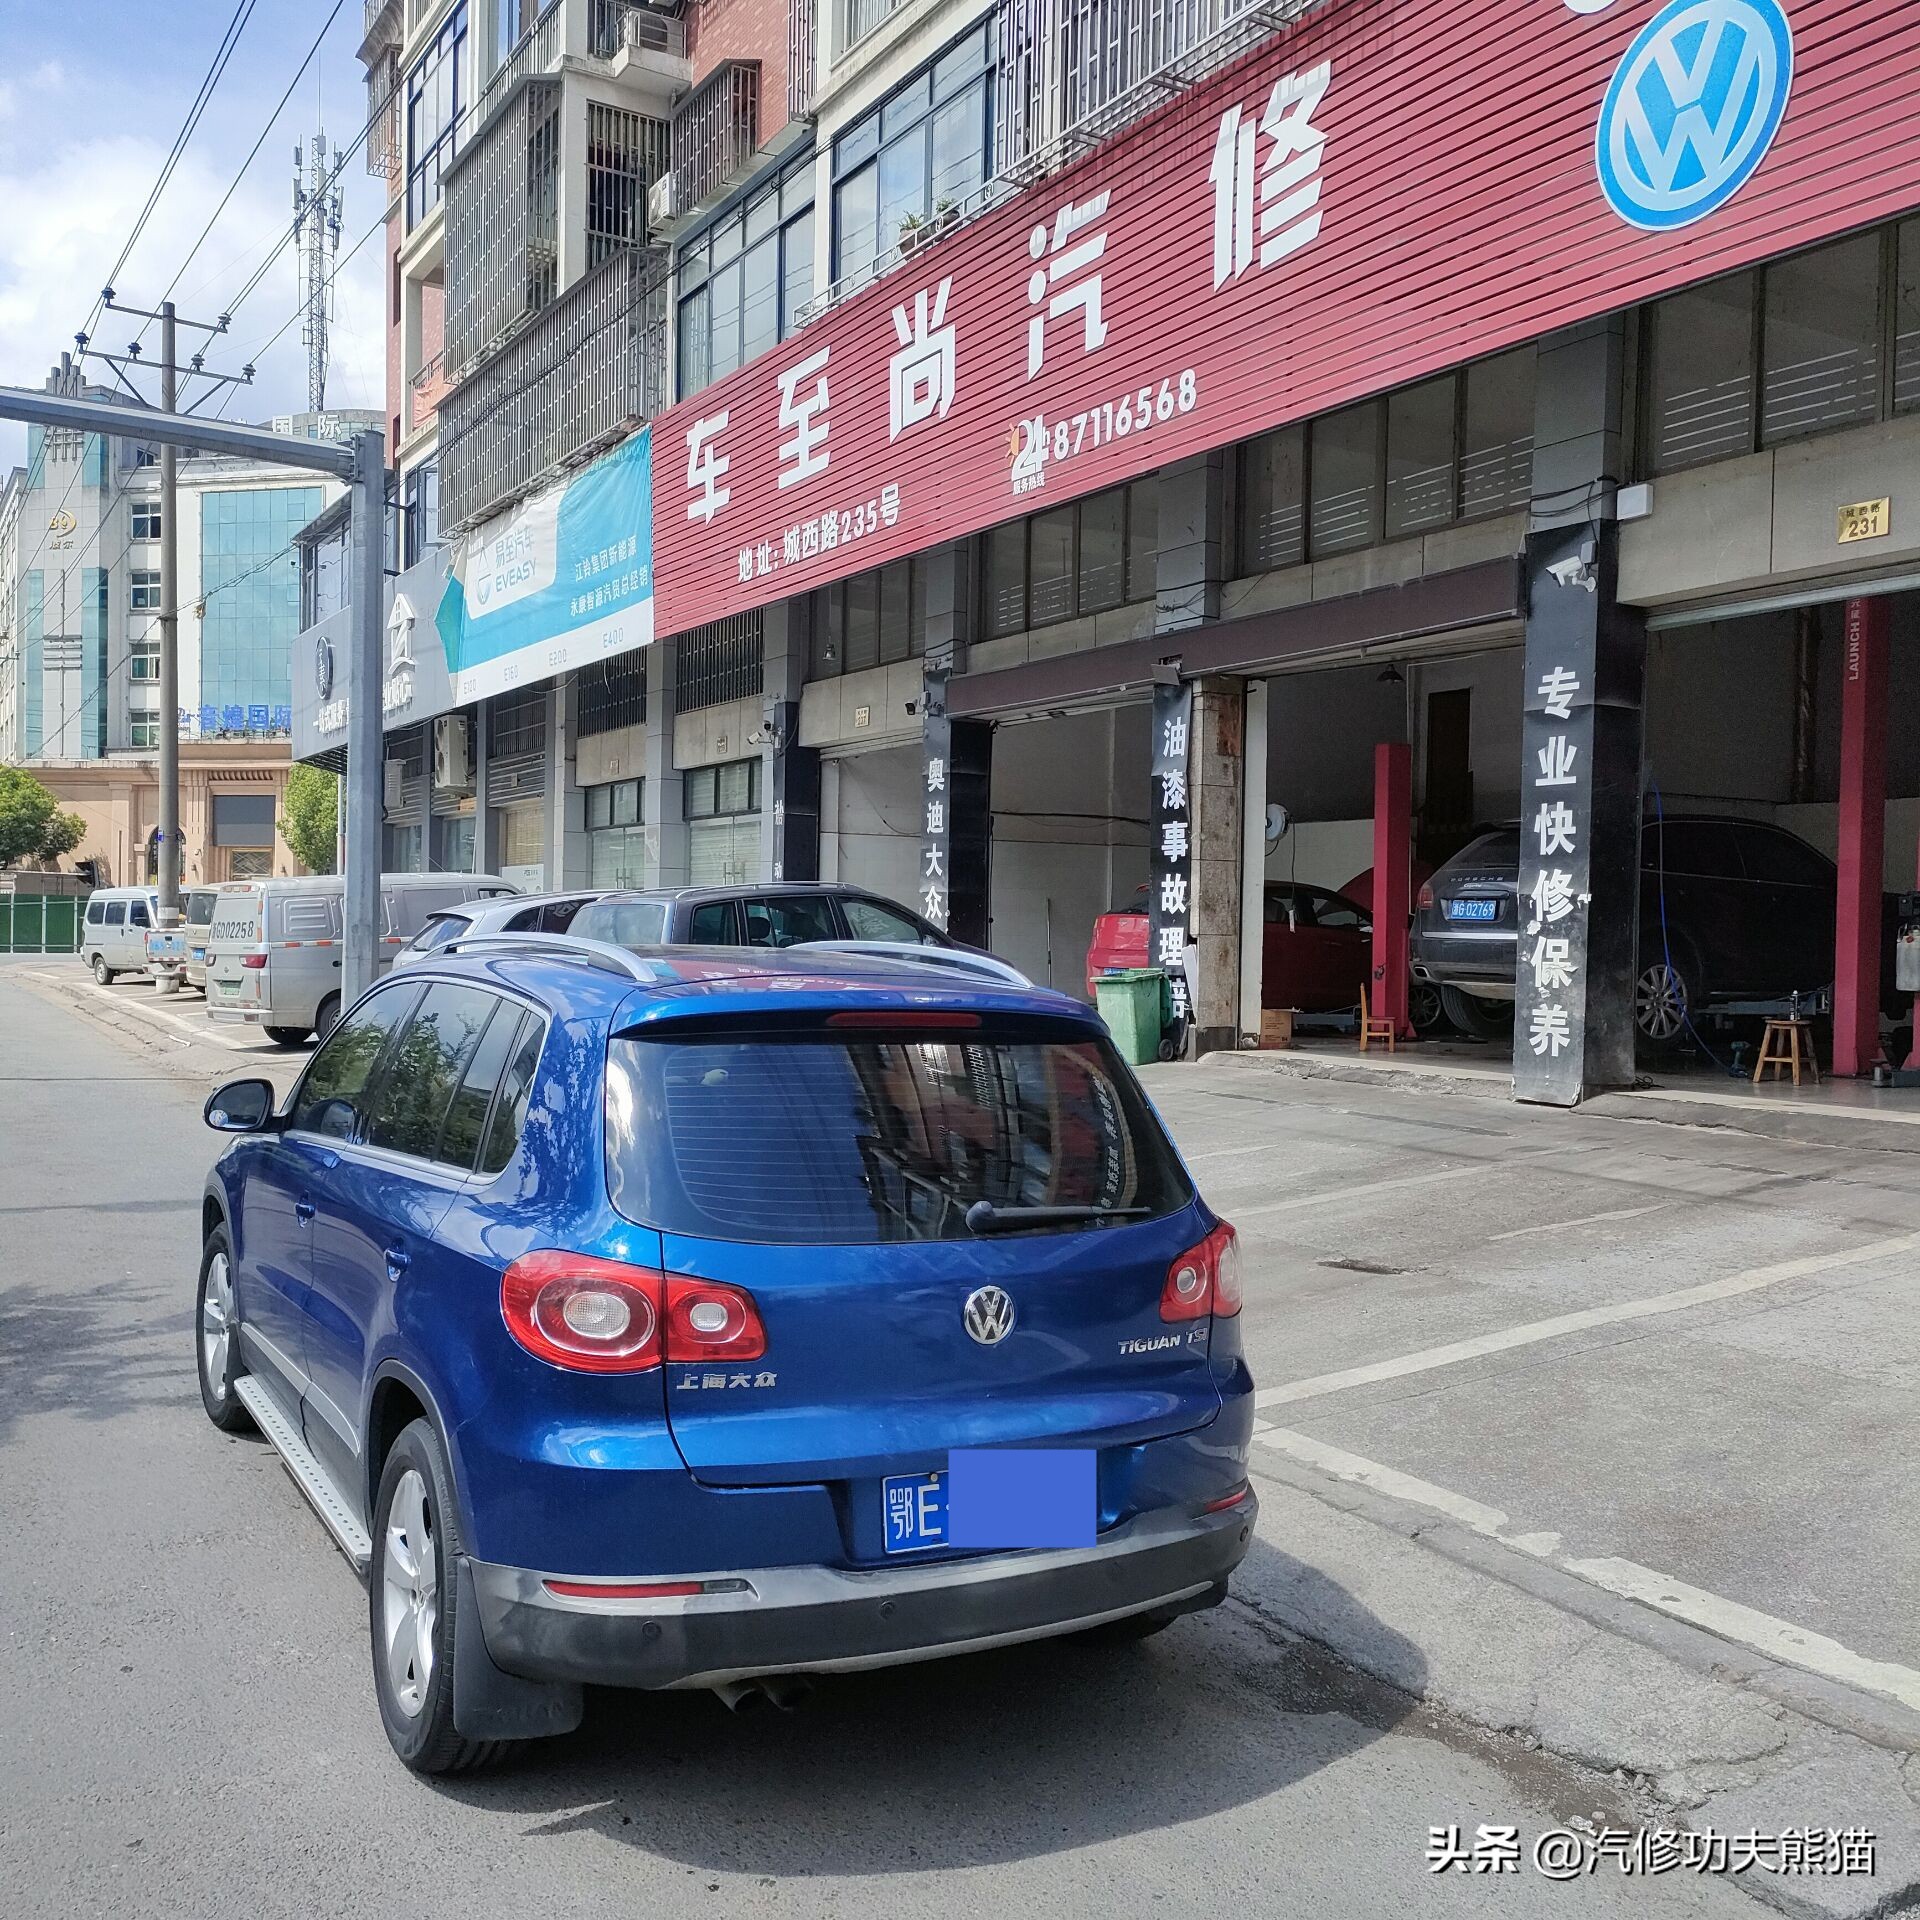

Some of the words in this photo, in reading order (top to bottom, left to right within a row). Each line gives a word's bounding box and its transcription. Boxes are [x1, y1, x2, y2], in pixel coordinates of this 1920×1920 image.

[685, 60, 1332, 526] 车至尚汽修
[1053, 369, 1197, 460] 87116568
[1012, 472, 1046, 496] 服务热线
[496, 524, 535, 569] 易至汽车
[1849, 516, 1878, 538] 231
[495, 557, 536, 592] EVEASY
[575, 535, 637, 582] 江铃集团新能源
[549, 648, 568, 666] E200
[602, 627, 624, 648] E400
[1849, 621, 1860, 681] LAUNCH
[924, 757, 945, 919] 奥迪大众
[1528, 666, 1581, 1056] 专业快修保养
[1117, 1334, 1181, 1355] TIGUAN
[676, 1371, 778, 1390] 上海大众
